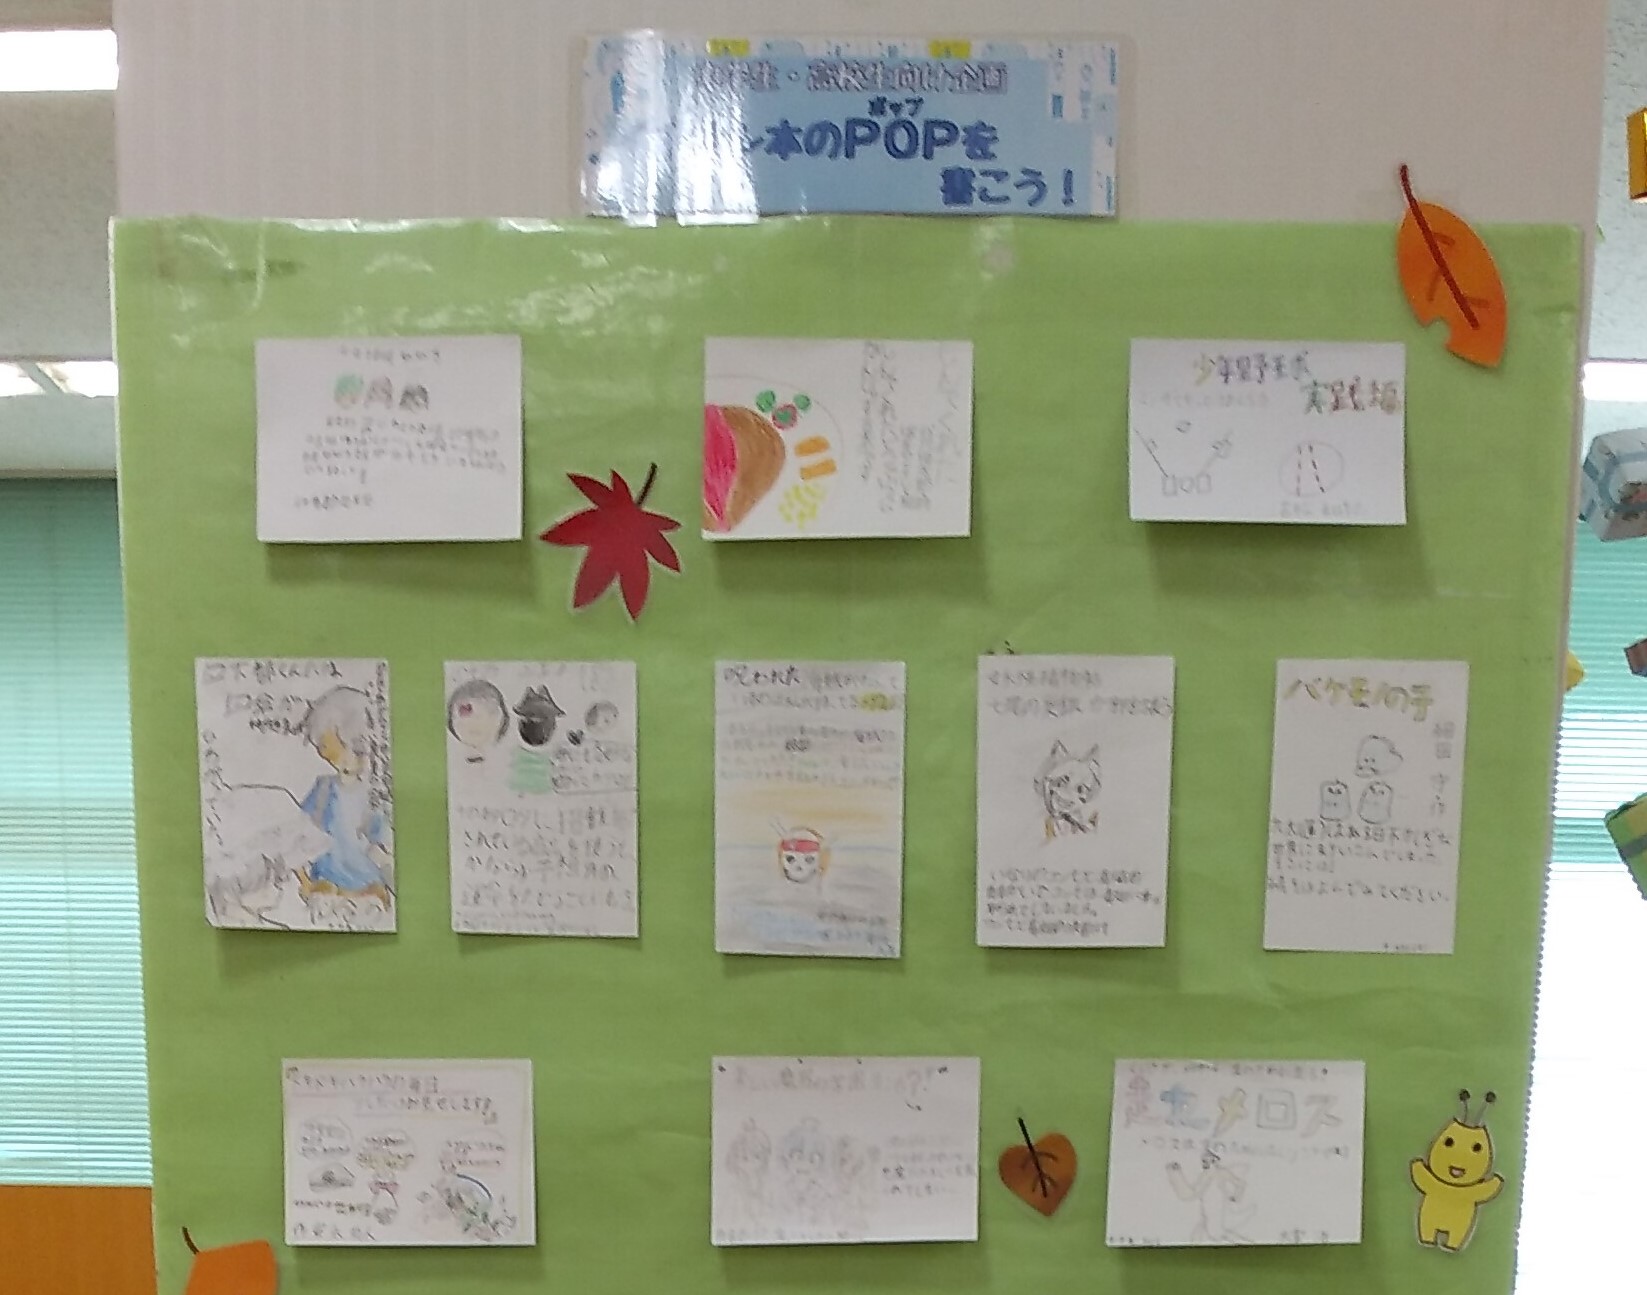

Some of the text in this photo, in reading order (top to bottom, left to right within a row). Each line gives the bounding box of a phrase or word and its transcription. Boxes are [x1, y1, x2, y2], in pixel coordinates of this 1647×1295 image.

[940, 165, 1077, 206] 書こう！
[1282, 676, 1435, 723] バケモノの子
